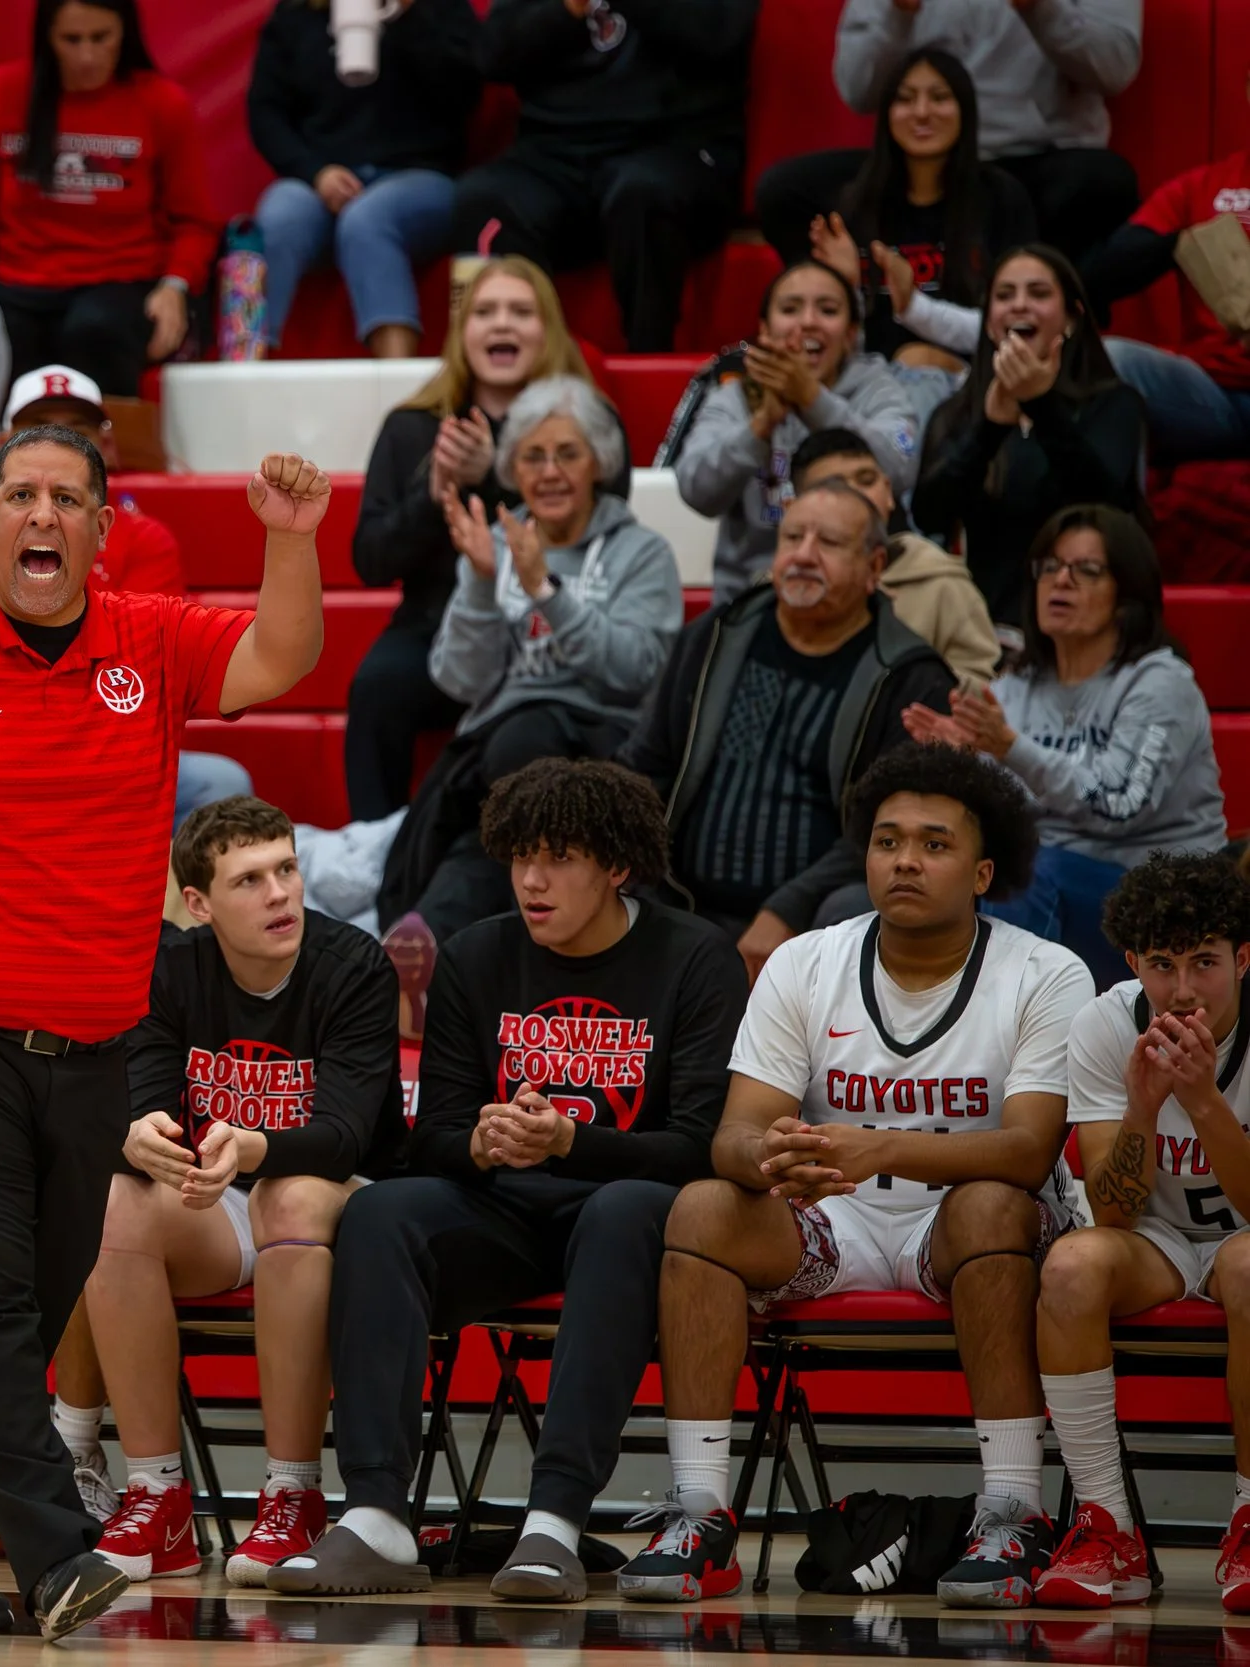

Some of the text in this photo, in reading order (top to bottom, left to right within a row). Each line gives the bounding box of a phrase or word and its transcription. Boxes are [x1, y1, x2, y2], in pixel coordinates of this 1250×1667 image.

[44, 374, 70, 397] R
[105, 667, 130, 687] R
[498, 1012, 654, 1053] ROSWELL
[186, 1046, 317, 1095] ROWELL
[504, 1047, 646, 1088] COYOTES
[190, 1083, 316, 1131] COOTES
[826, 1069, 989, 1118] COYOTES
[1184, 1184, 1240, 1231] 5
